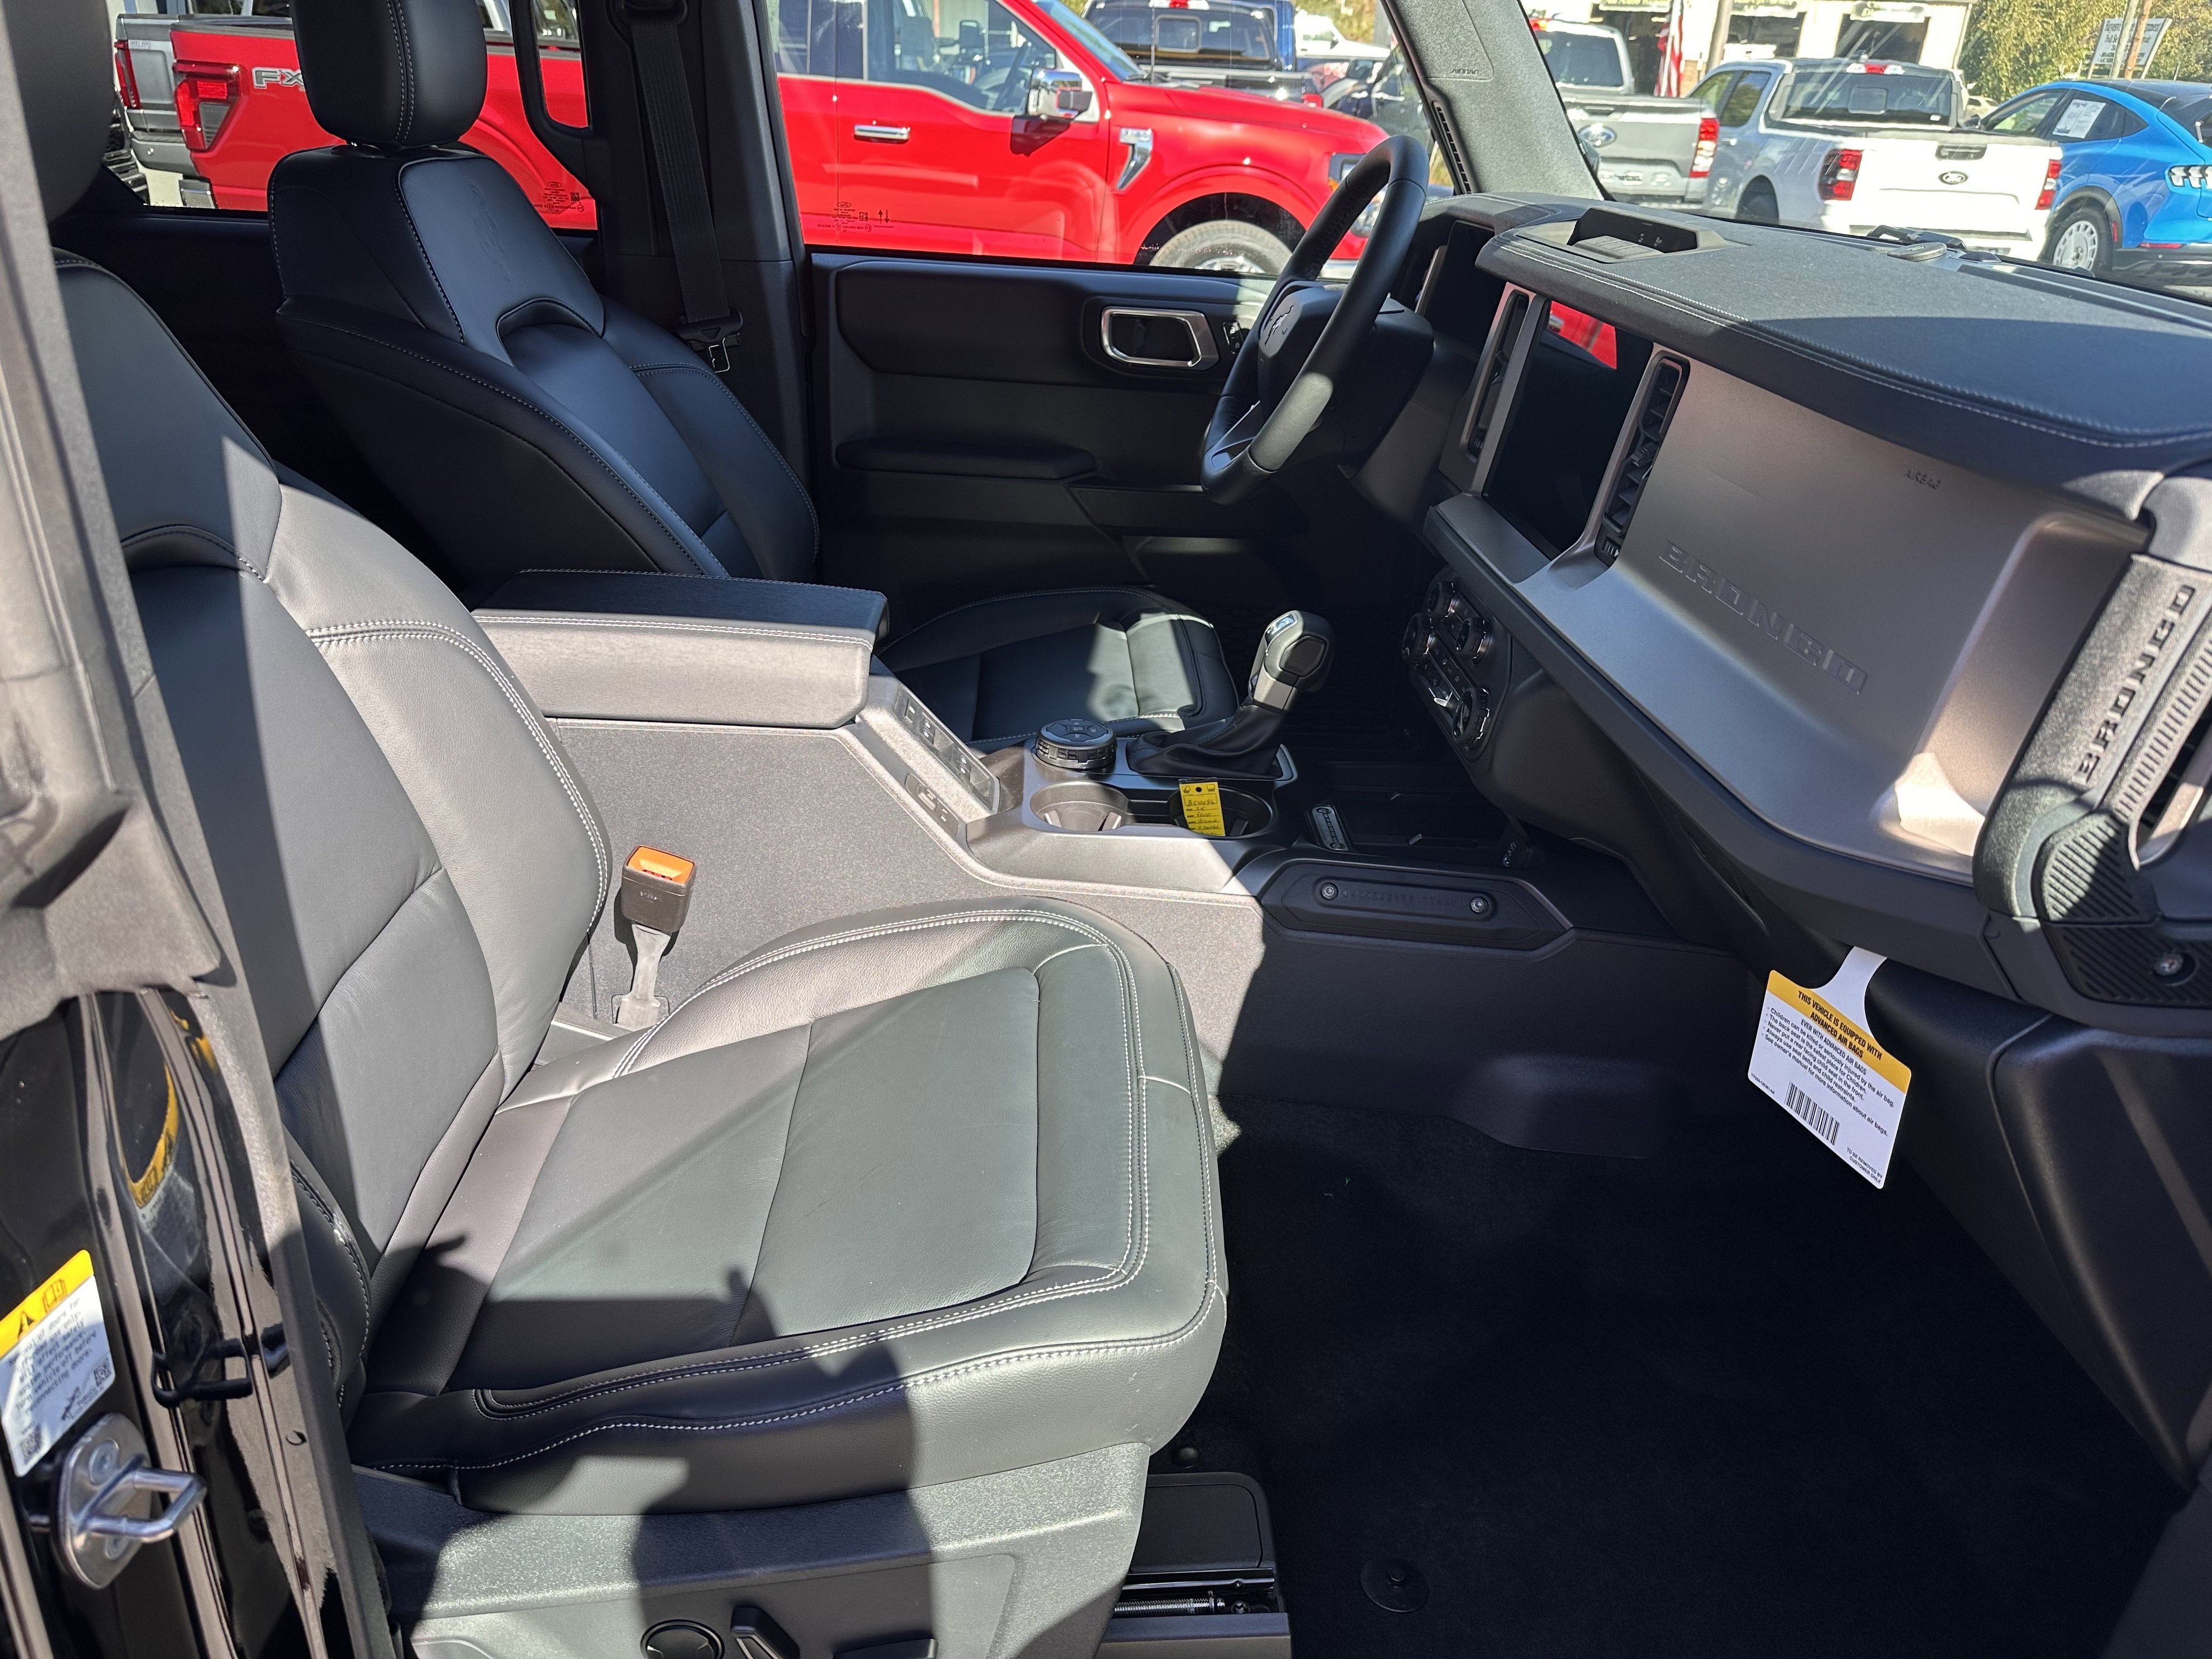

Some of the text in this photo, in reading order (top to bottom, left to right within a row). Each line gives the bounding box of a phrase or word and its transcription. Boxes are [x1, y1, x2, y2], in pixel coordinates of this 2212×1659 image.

[1659, 538, 1867, 695] BRONCO
[2073, 584, 2196, 783] BRONCO
[1798, 990, 1882, 1060] THIS VEHICLE IS EQUIPPED WITH
[1801, 1019, 1866, 1075] EVEN WITH ADVANCED AIR BAGS
[1810, 1012, 1863, 1058] ADVANCED AIR BAGS
